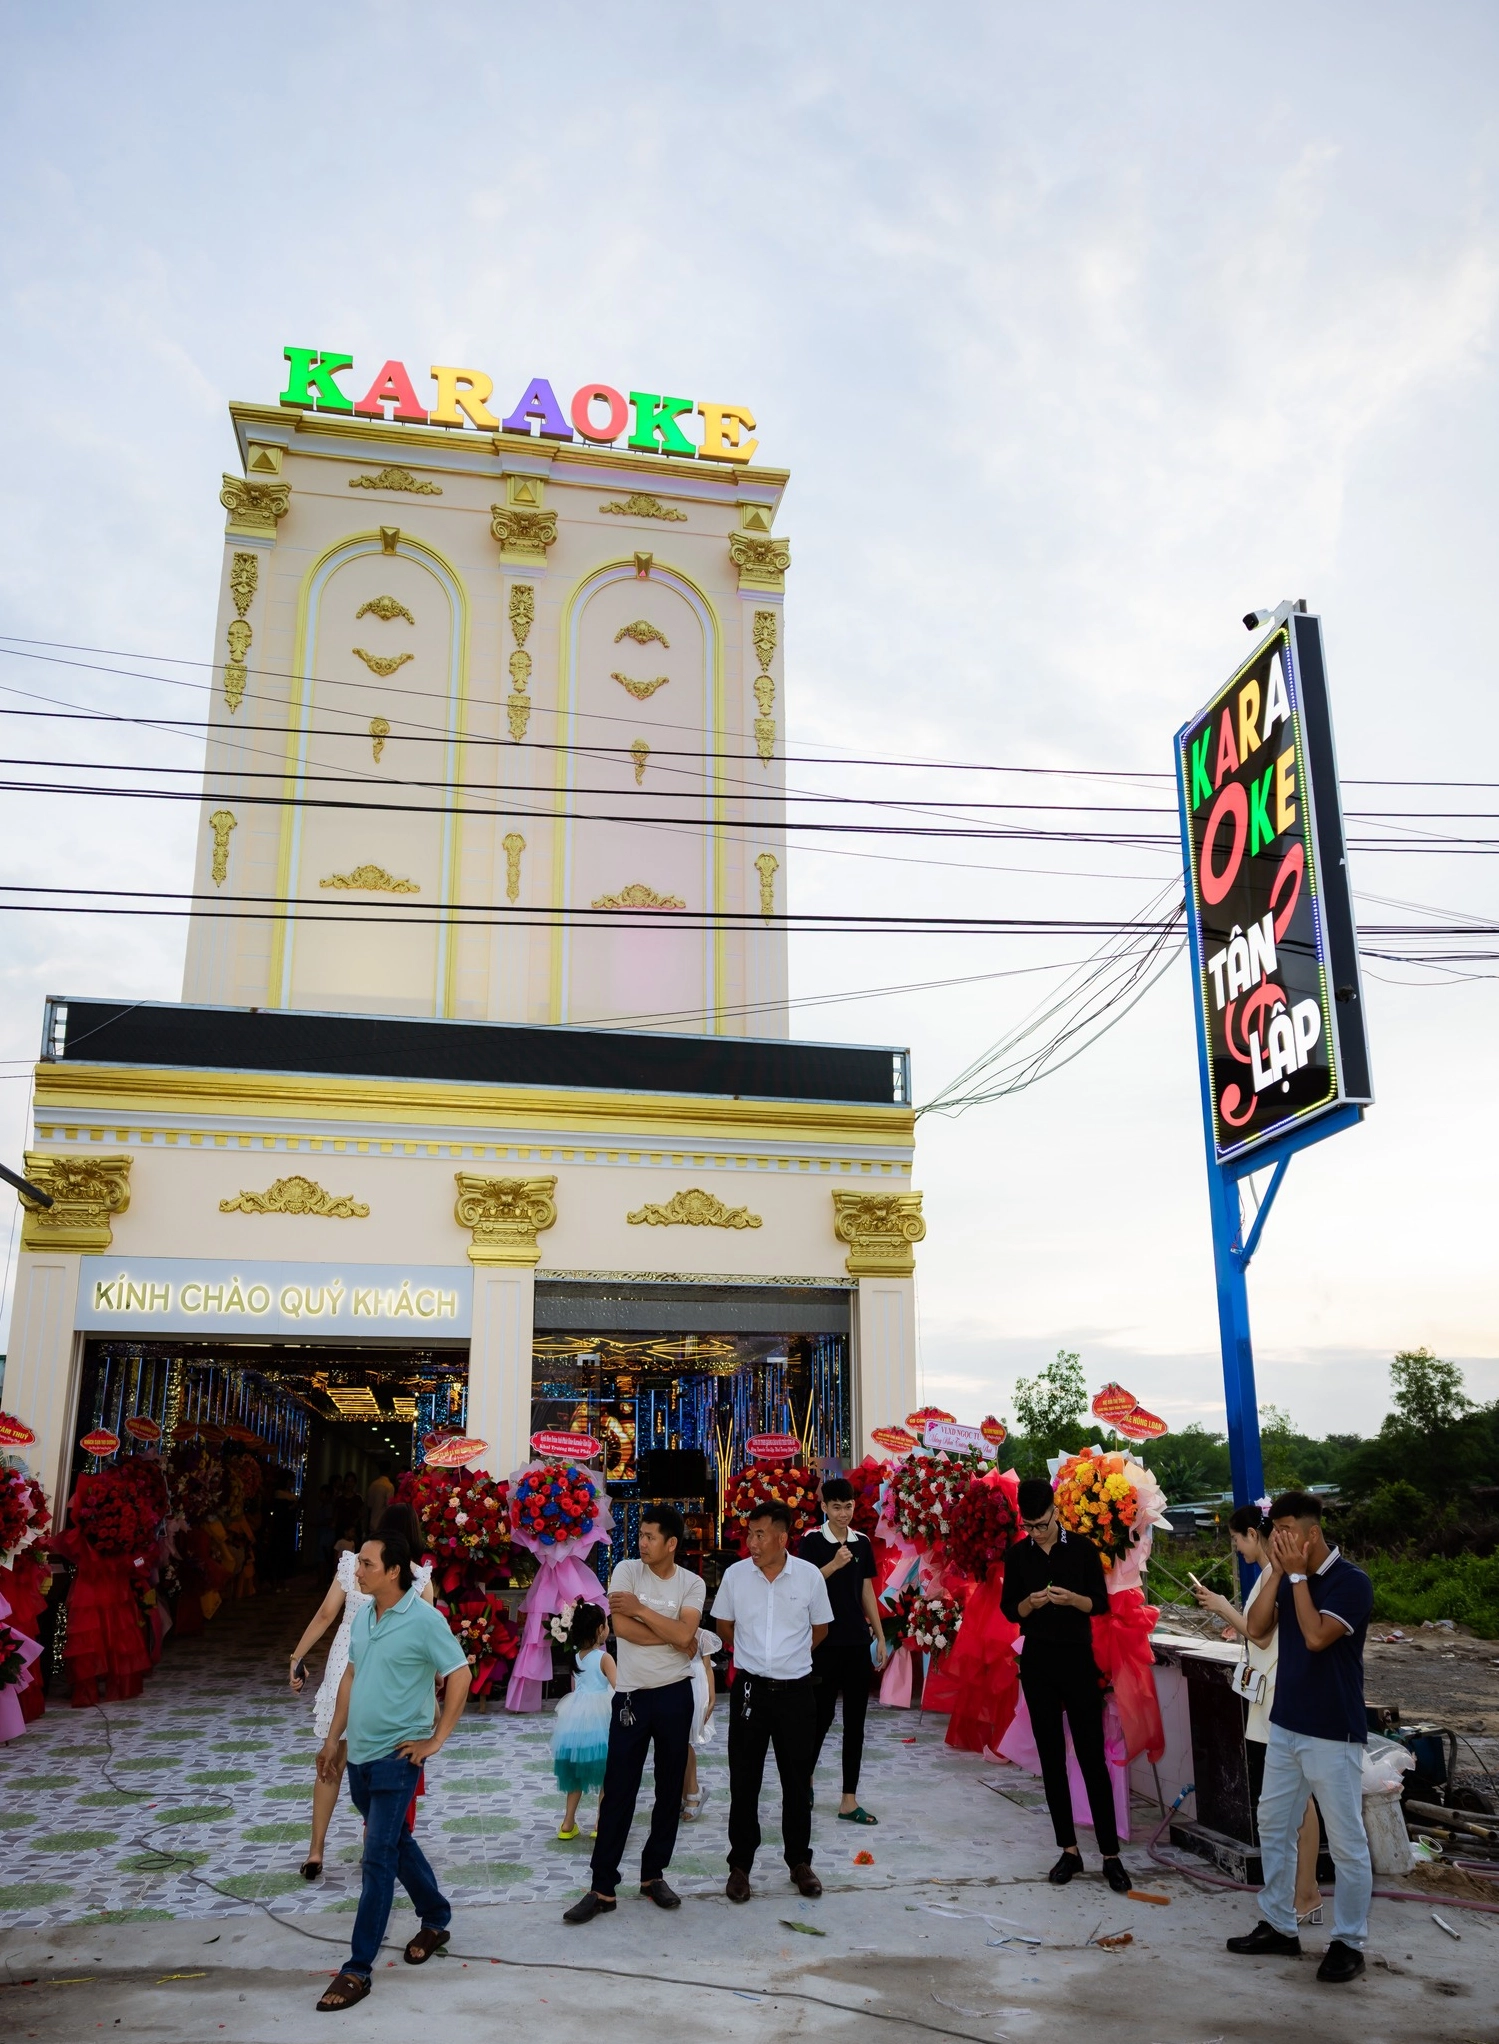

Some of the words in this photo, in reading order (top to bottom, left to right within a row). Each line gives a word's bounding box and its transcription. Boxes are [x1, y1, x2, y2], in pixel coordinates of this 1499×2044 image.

[279, 346, 760, 465] KARAOKE
[1191, 651, 1290, 811] KARA
[1200, 744, 1297, 906] OKE
[1208, 910, 1277, 1013] TÂN
[1248, 997, 1322, 1096] LẬP
[94, 1273, 171, 1312] KÍNH
[179, 1275, 271, 1314] CHÀO
[279, 1278, 345, 1318] QUÝ
[353, 1280, 457, 1318] KHÁCH
